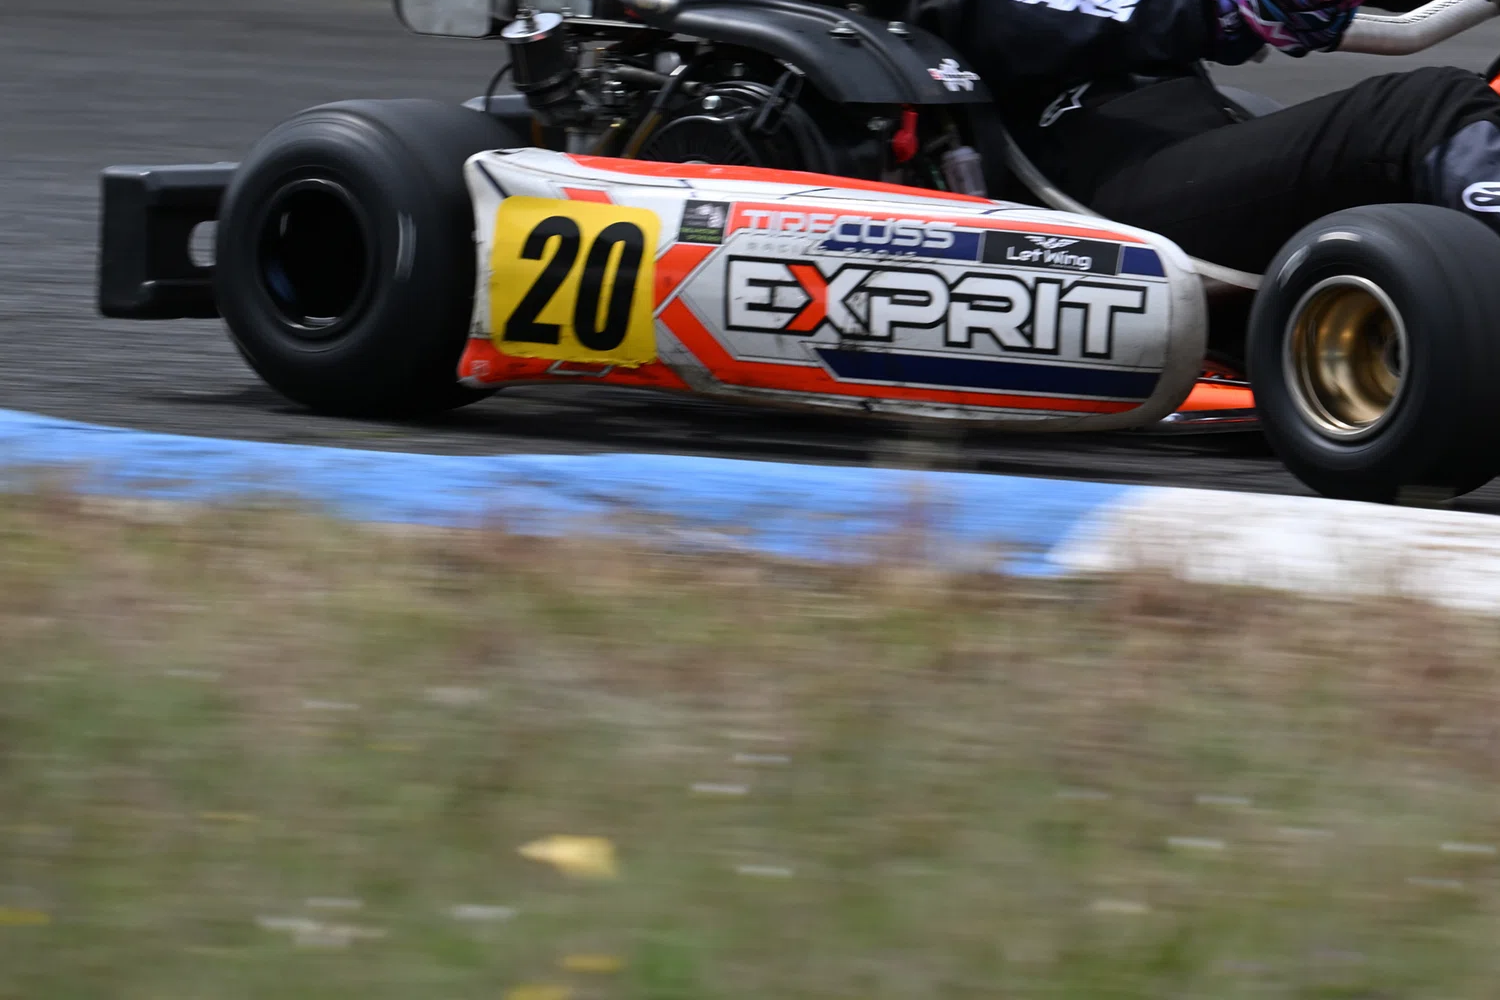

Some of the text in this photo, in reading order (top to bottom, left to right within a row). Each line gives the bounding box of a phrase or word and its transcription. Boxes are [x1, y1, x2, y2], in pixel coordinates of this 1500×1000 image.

[741, 209, 957, 250] TIRECUSS
[1006, 246, 1093, 271] Let Wing
[502, 215, 645, 352] 20
[725, 255, 1148, 360] EXPRIT
